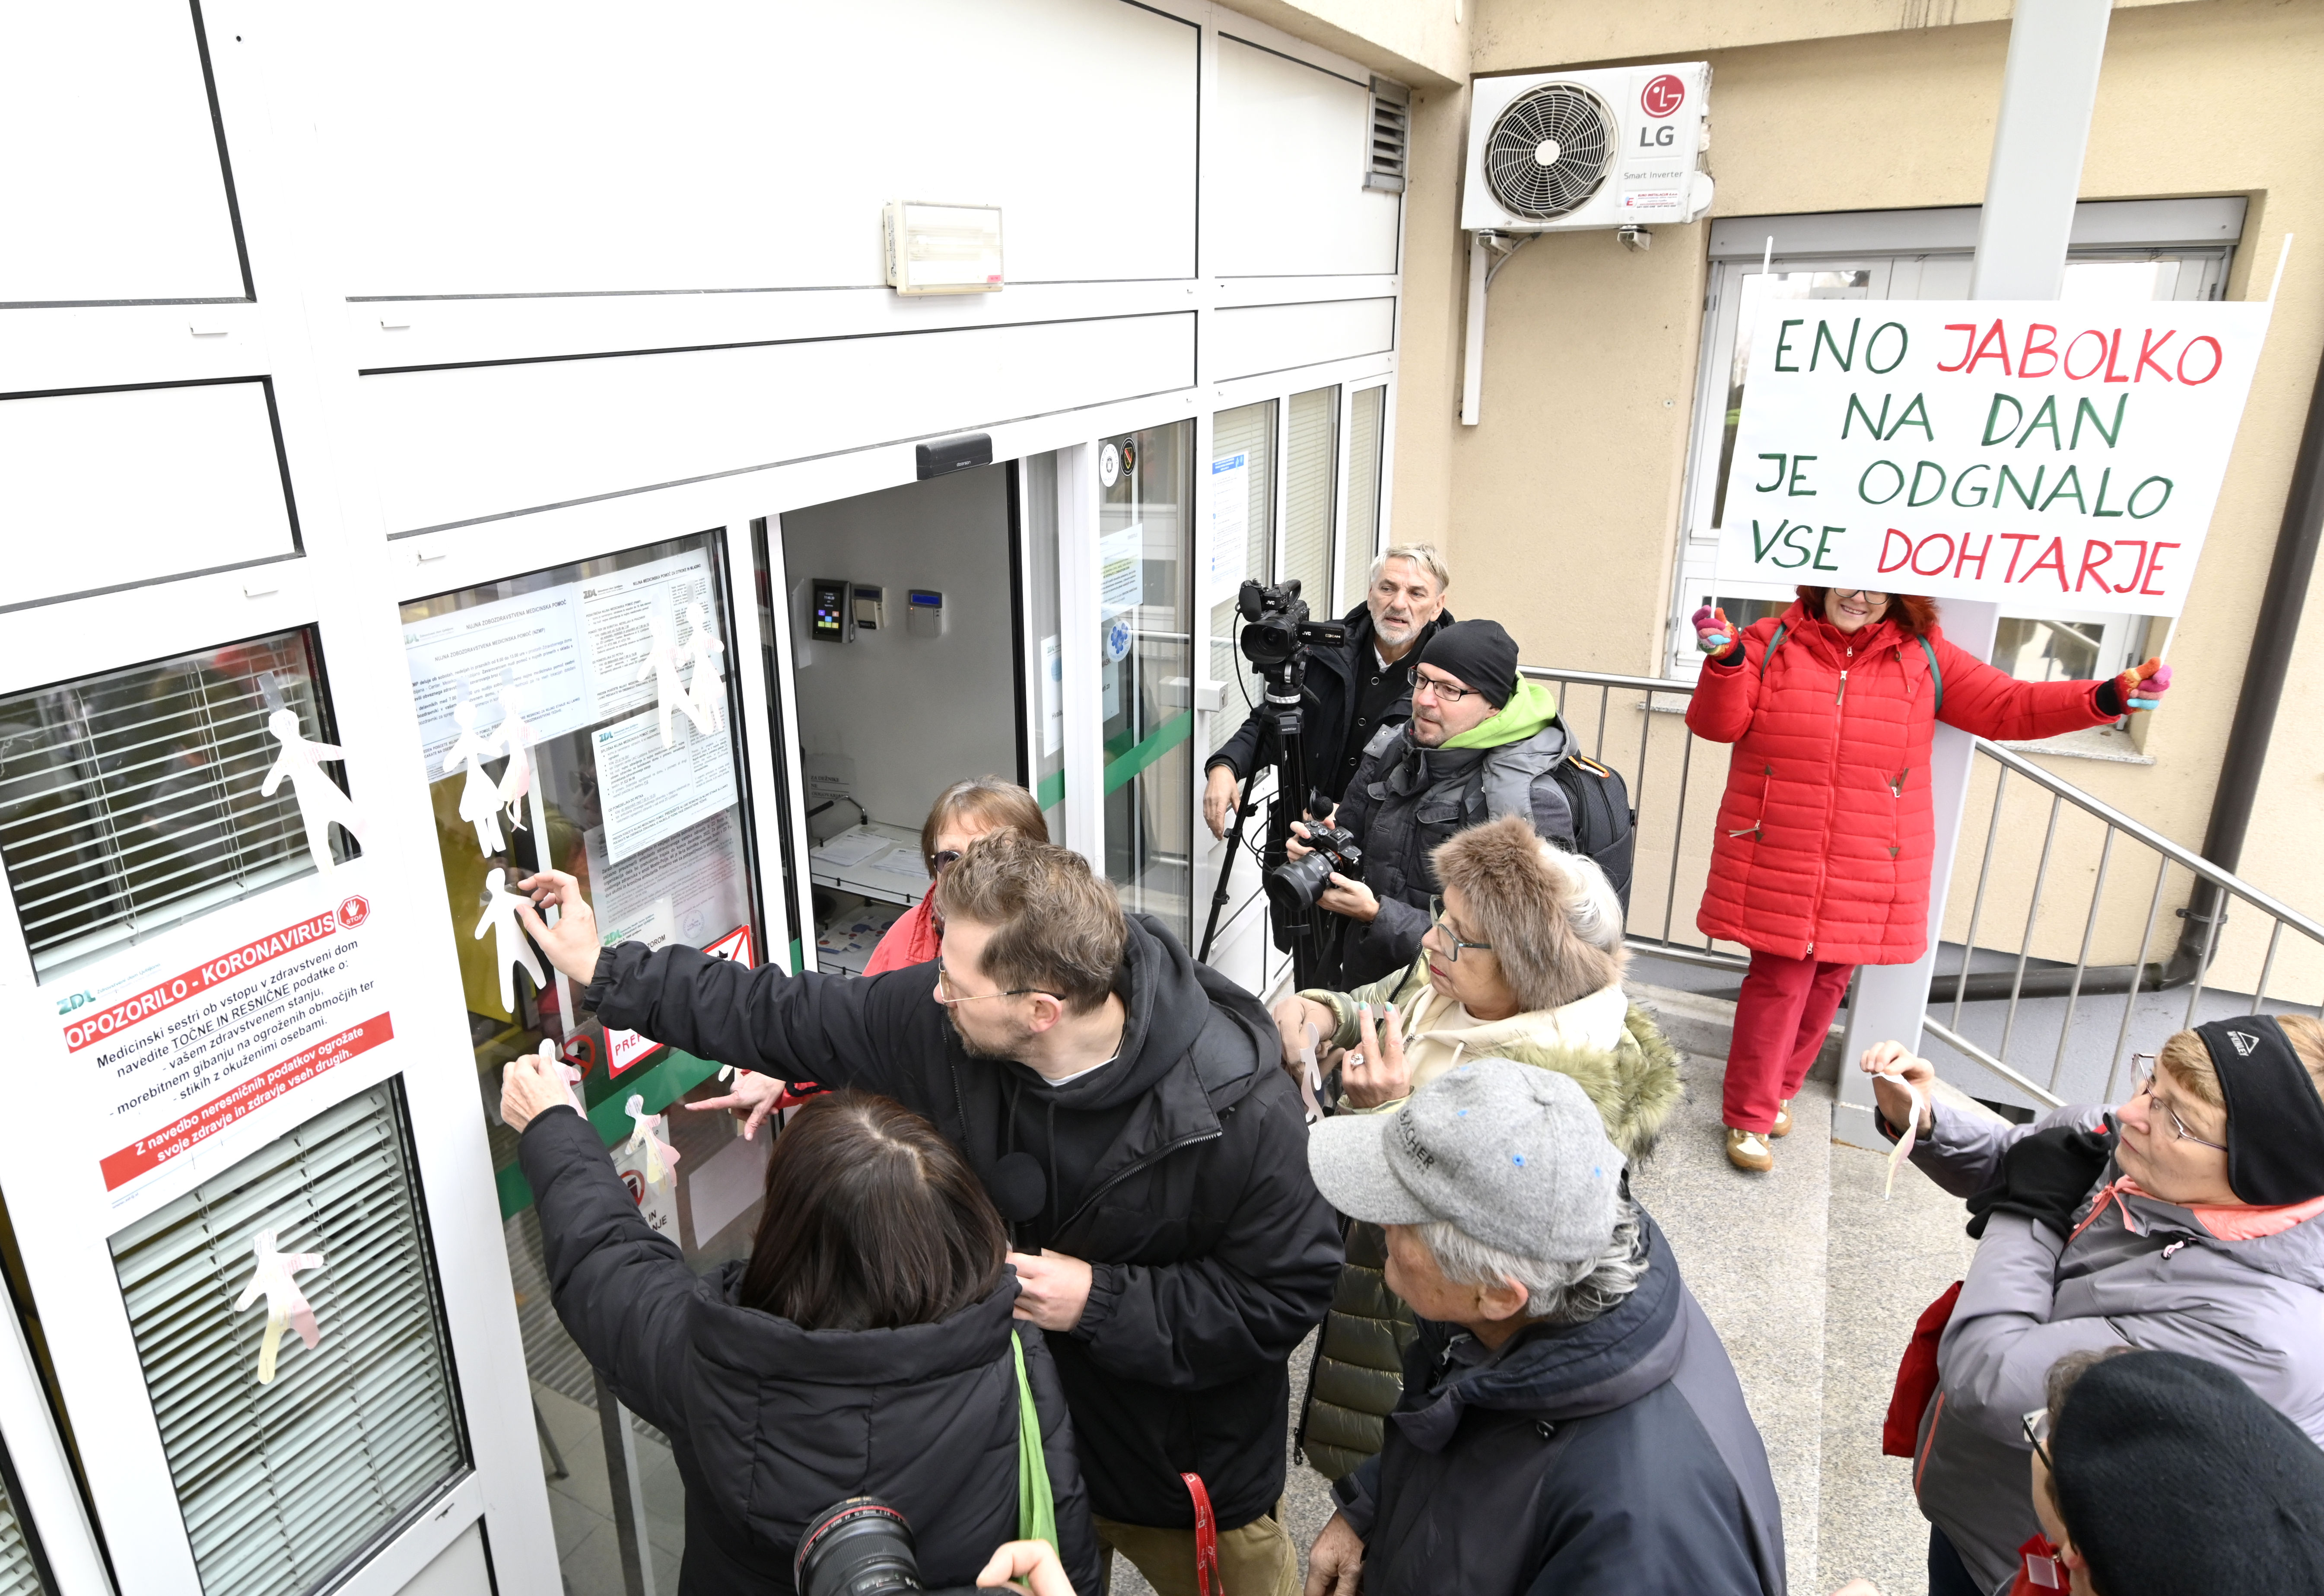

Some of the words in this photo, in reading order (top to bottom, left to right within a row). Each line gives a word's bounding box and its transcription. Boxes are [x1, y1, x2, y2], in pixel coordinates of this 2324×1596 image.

[1640, 126, 1674, 147] LG
[1775, 318, 1908, 374] ENO
[1937, 318, 2222, 385] JABOLKO
[1841, 392, 1934, 441] NA
[1982, 392, 2128, 450] DAN
[1756, 453, 1817, 496] JE
[1858, 459, 2174, 519] ODGNALO
[643, 575, 660, 583] MEDICINSKA
[1752, 519, 1846, 571] VSE
[1877, 528, 2181, 595] DOHTARJE
[466, 621, 481, 630] NUJNA
[482, 609, 525, 626] ZOBOZDRAVSTVENA
[526, 603, 551, 615] MEDICINSKA
[552, 598, 566, 608] POMOČ
[435, 653, 449, 662] NUJNA
[450, 641, 491, 658] ZOBOZDRAVSTVENA
[492, 634, 516, 646] MEDICINSKA
[517, 630, 531, 639] POMOČ
[532, 627, 545, 636] (NZMP)
[419, 677, 431, 686] deluje
[598, 730, 613, 742] ZDL
[346, 912, 364, 926] STOP
[603, 929, 623, 946] ZDL
[56, 989, 96, 1016] ZDL
[64, 977, 189, 1051] OPOZORILO
[201, 912, 336, 986] KORONAVIRUS
[97, 978, 126, 994] Zdravstveni
[139, 963, 161, 976] Ljubljana
[97, 1030, 164, 1068] Medicinski
[168, 1013, 200, 1034] sestri
[203, 1003, 217, 1016] ob
[220, 984, 258, 1007] vstopu
[270, 952, 331, 984] zdravstveni
[335, 941, 358, 956] dom
[117, 1046, 168, 1077] navedite
[171, 1020, 214, 1048] TOČNE
[216, 1013, 229, 1026] IN
[232, 983, 290, 1019] RESNIČNE
[293, 966, 335, 992] podatke
[338, 959, 348, 971] o:
[169, 1045, 207, 1068] vašem
[210, 1005, 285, 1048] zdravstvenem
[288, 988, 320, 1009] stanju,
[118, 1071, 190, 1114] morebitnem
[193, 1048, 234, 1077] gibanju
[237, 1039, 250, 1051] na
[253, 1010, 305, 1042] ogroženih
[309, 987, 357, 1015] območjih
[360, 981, 374, 992] ter
[180, 1077, 210, 1099] stikih
[214, 1072, 220, 1081] z
[223, 1042, 277, 1076] okuženimi
[280, 1018, 324, 1045] osebami.
[134, 1141, 146, 1157] Z
[146, 1111, 199, 1150] navedbo
[200, 1073, 265, 1121] neresničnih
[267, 1047, 316, 1085] podatkov
[318, 1023, 364, 1060] ogrožate
[156, 1134, 191, 1165] svoje
[190, 1109, 233, 1145] zdravje
[234, 1102, 246, 1118] in
[246, 1079, 286, 1113] zdravje
[287, 1065, 313, 1089] vseh
[315, 1043, 353, 1076] drugih.
[649, 1210, 656, 1222] IN
